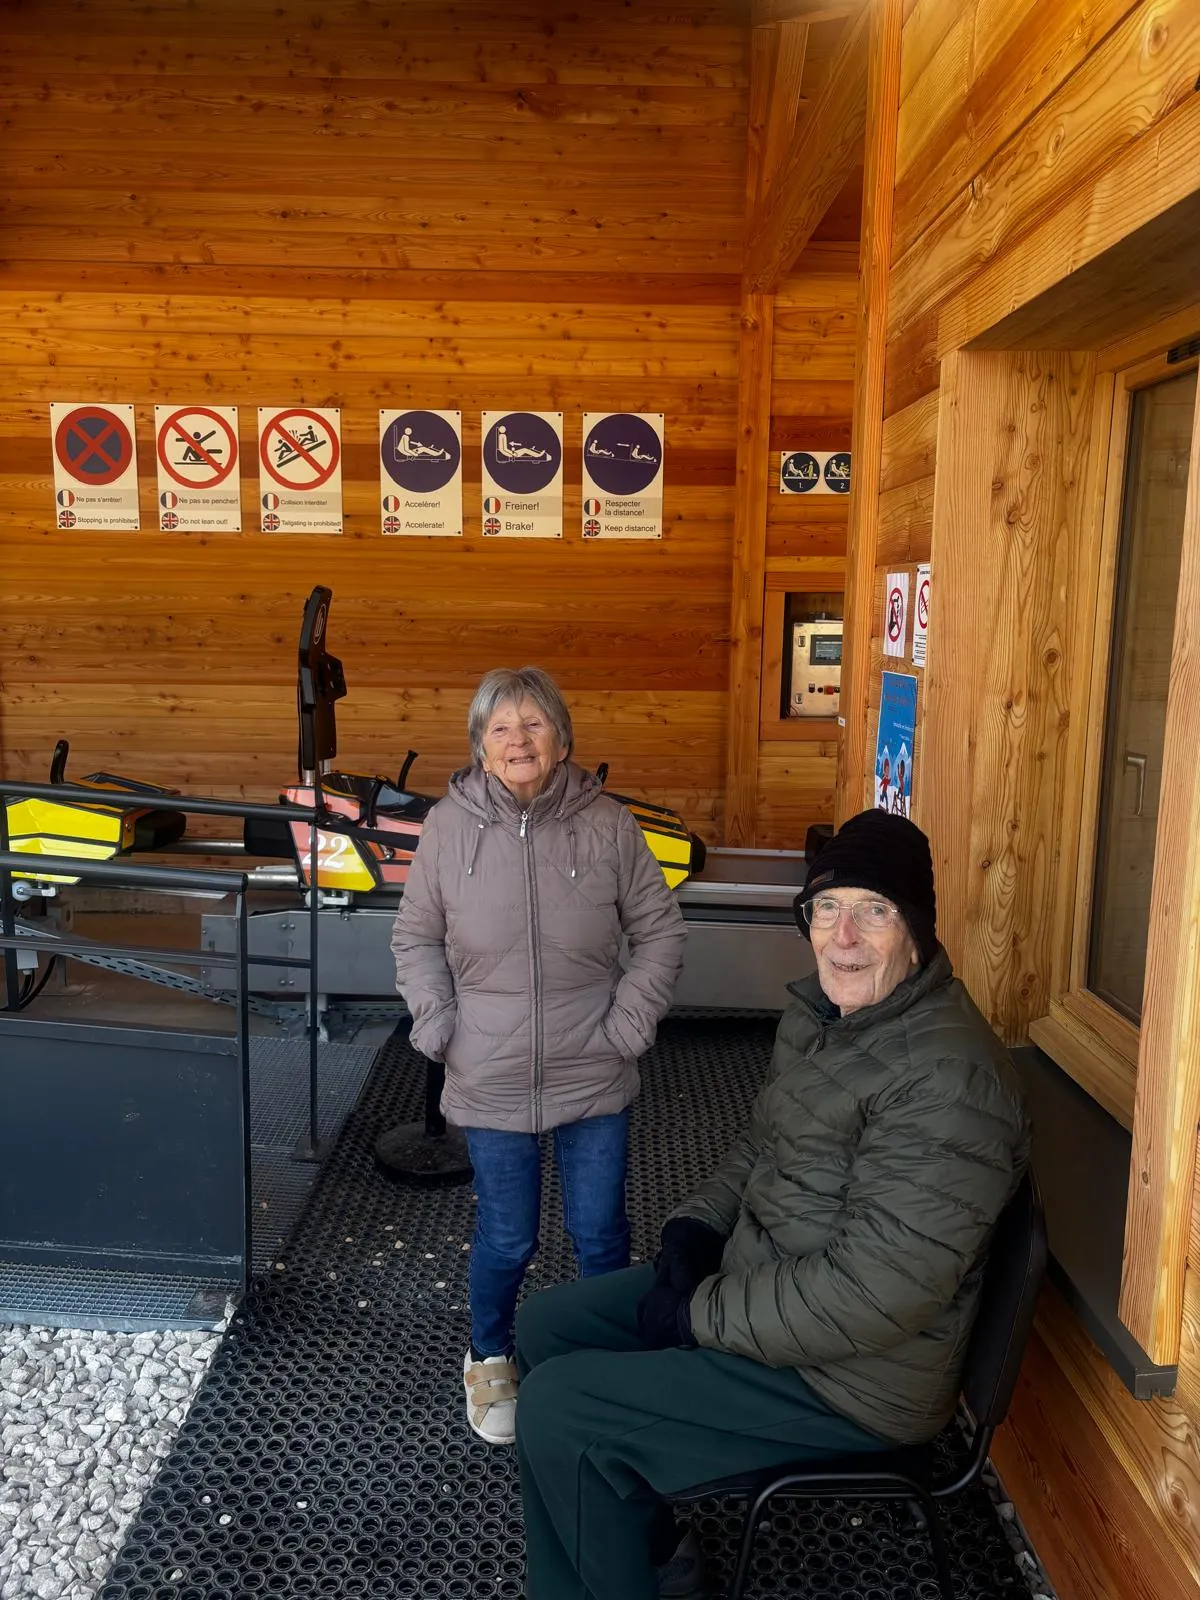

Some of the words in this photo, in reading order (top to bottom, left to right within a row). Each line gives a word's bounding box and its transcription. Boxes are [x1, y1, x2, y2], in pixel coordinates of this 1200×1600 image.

[505, 501, 540, 510] Freiner!
[605, 500, 641, 508] Respecter
[78, 516, 102, 524] Stopping
[110, 517, 138, 525] prohibited!
[505, 522, 534, 531] Brake!
[302, 834, 348, 868] 22
